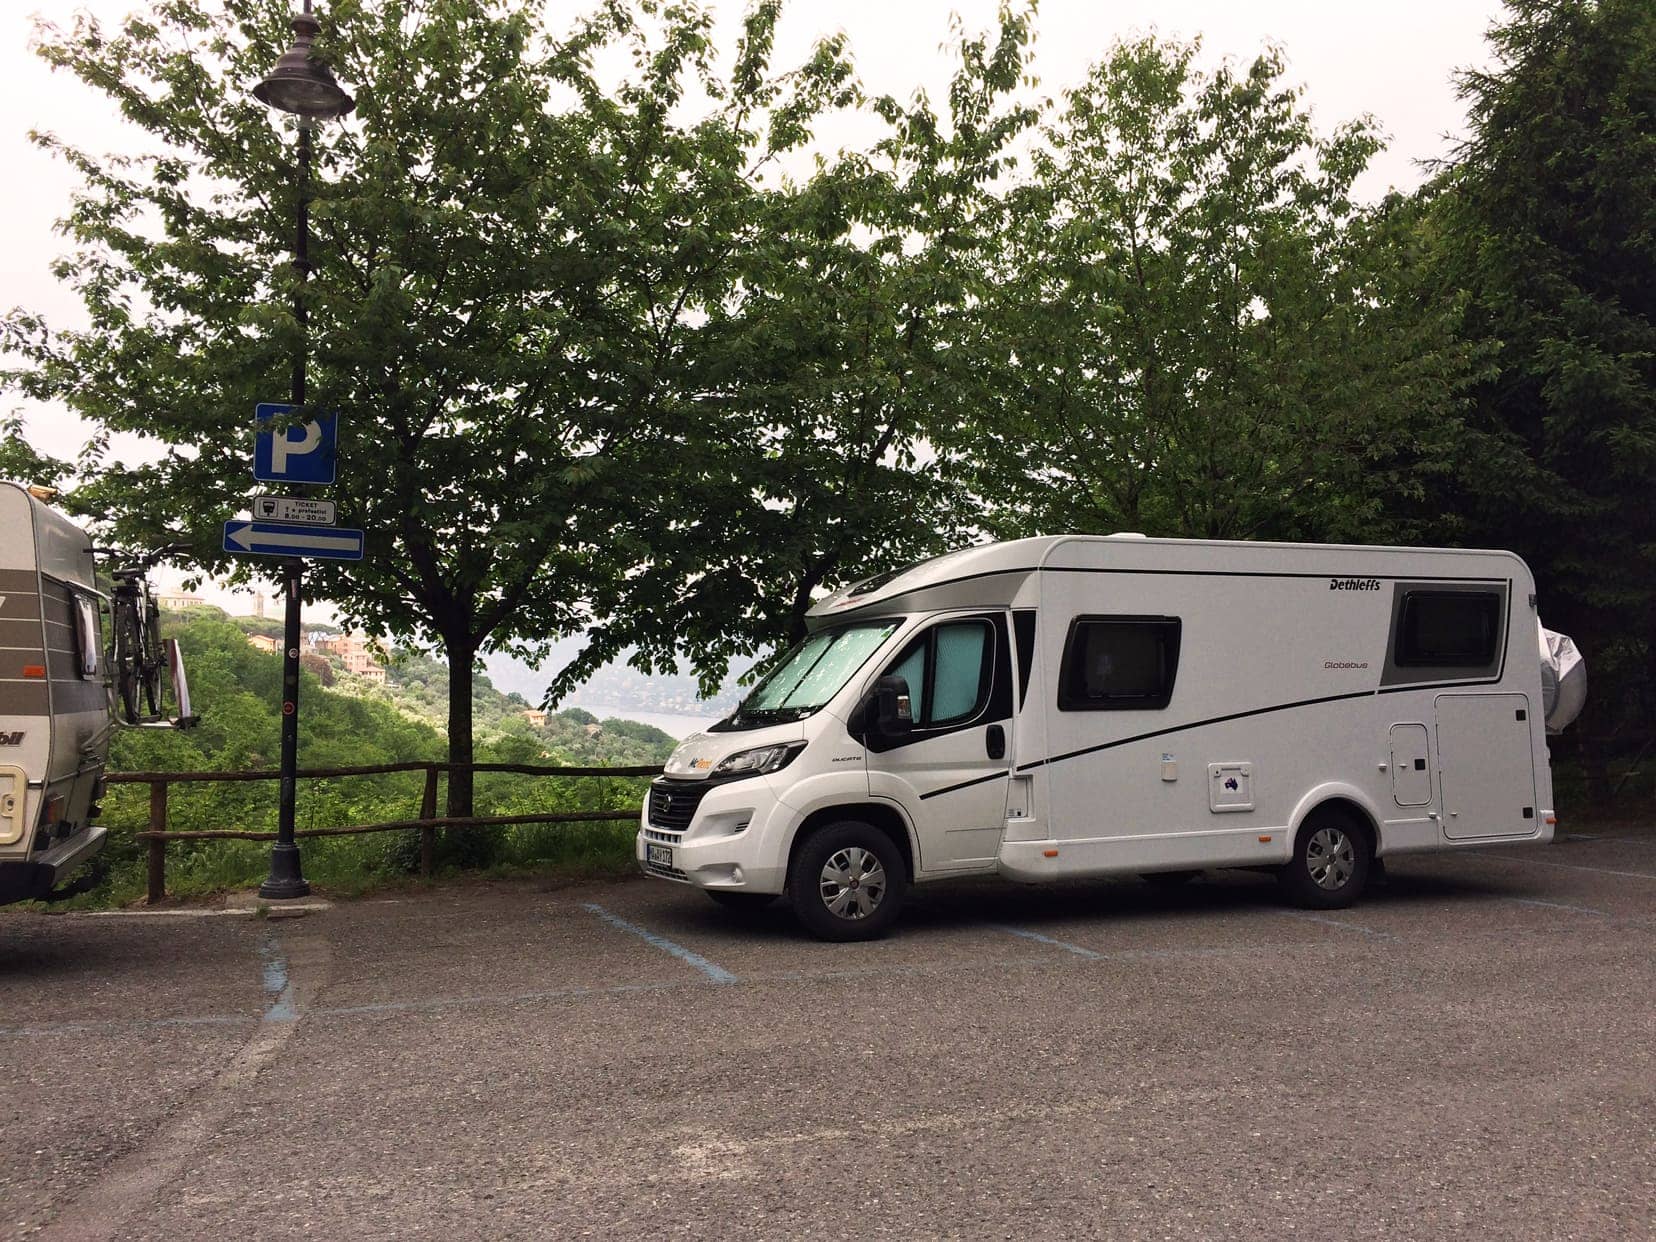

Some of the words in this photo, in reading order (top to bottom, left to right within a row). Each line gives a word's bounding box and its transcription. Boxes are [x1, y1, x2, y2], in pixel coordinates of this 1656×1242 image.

[271, 418, 321, 473] P
[1329, 579, 1380, 591] Dethleffs
[1324, 661, 1368, 669] Globebus
